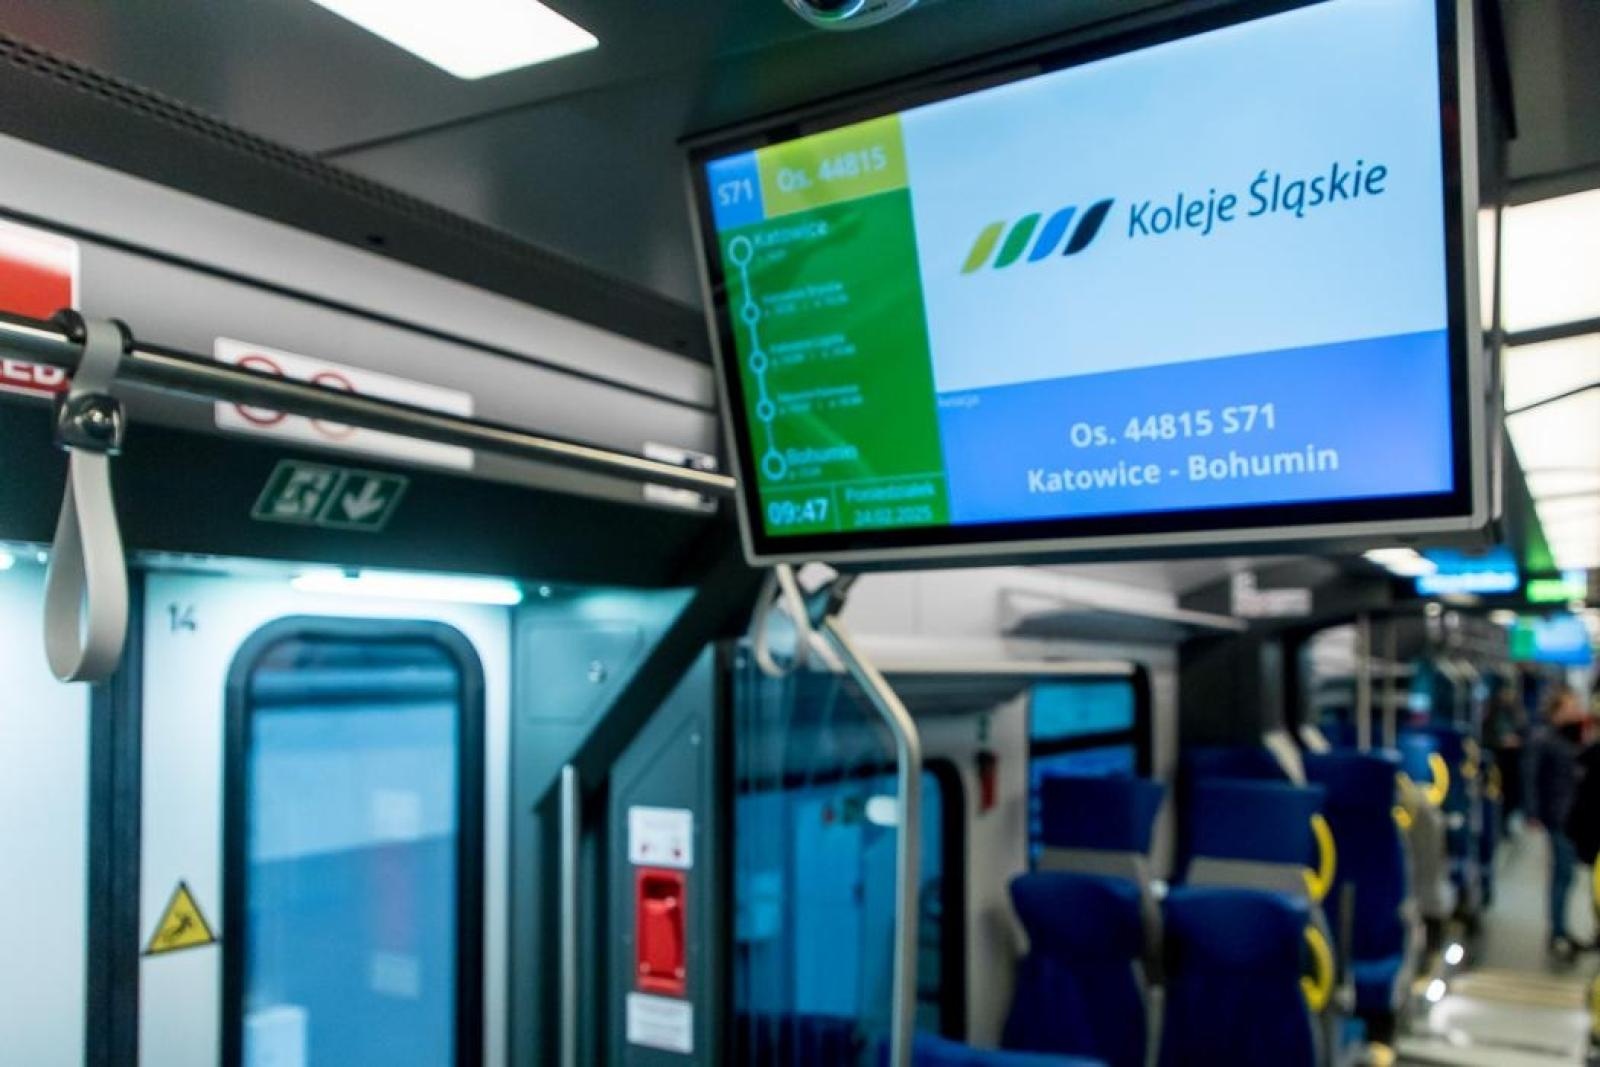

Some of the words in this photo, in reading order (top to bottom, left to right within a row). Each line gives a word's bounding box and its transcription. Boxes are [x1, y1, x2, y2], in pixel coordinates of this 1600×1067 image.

[718, 178, 754, 206] S71
[1128, 188, 1237, 238] Koleje
[1247, 159, 1388, 219] Śląskie
[1070, 422, 1116, 448] Os.
[1124, 409, 1213, 442] 44815
[1222, 403, 1275, 433] S71
[1027, 460, 1161, 493] Katowice
[768, 497, 828, 526] 09:47
[167, 604, 196, 633] 14
